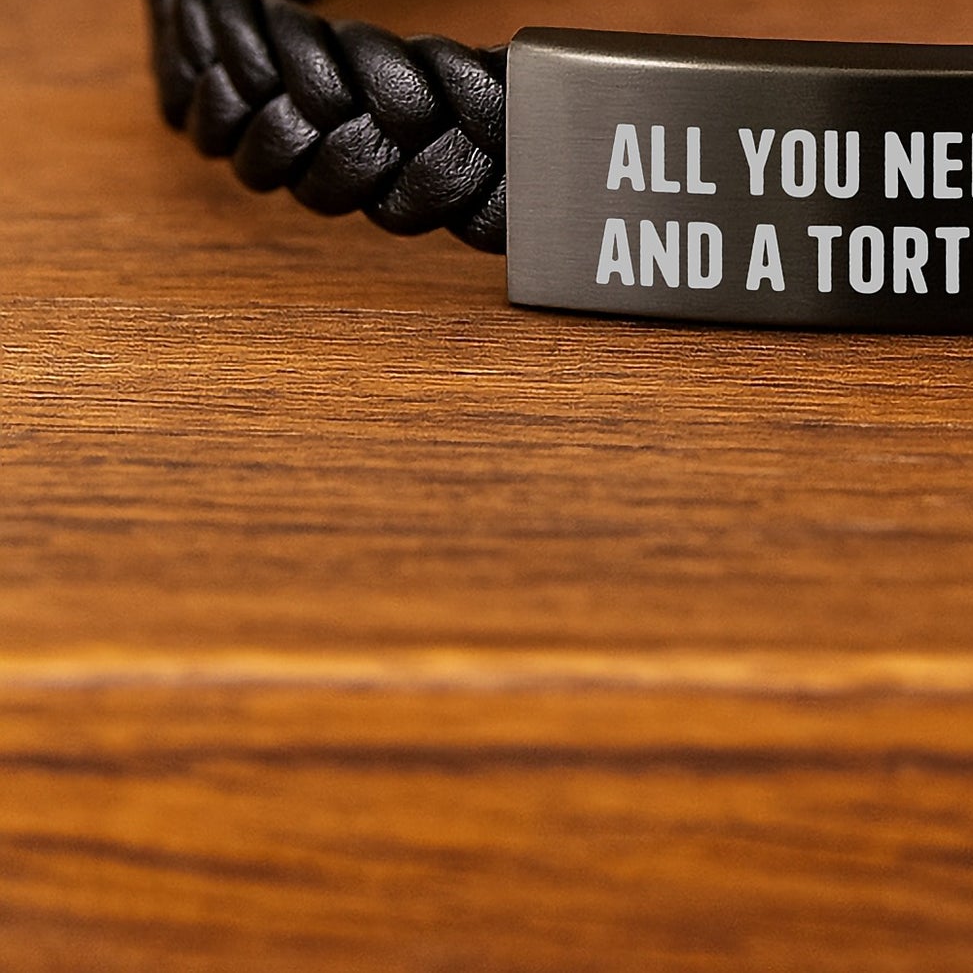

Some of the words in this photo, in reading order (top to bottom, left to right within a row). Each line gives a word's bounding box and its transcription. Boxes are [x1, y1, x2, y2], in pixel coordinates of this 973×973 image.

[606, 123, 717, 195] ALL
[738, 128, 860, 199] YOU
[595, 217, 724, 289] AND
[745, 223, 786, 292] A
